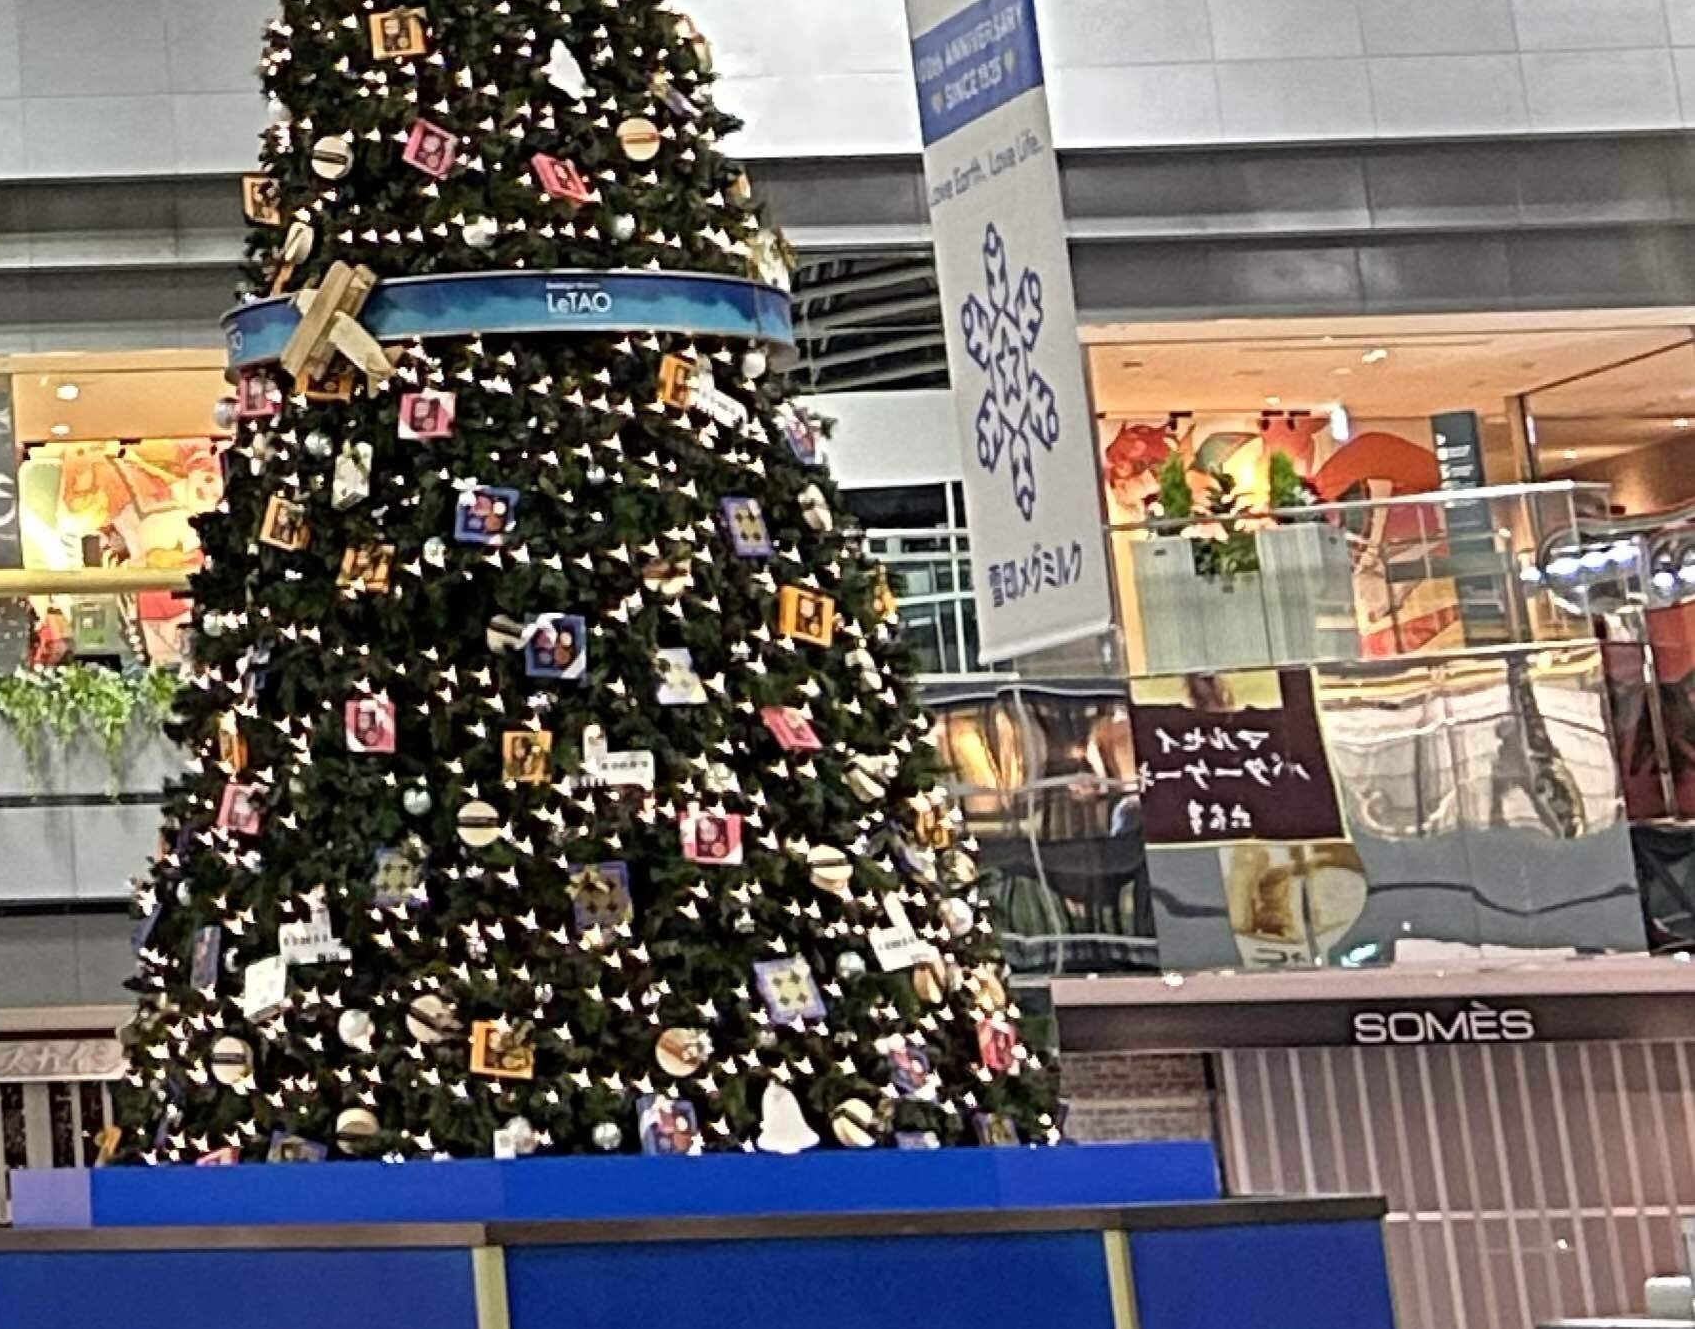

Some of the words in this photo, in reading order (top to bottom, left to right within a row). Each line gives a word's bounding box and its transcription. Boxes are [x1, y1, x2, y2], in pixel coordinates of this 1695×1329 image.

[943, 68, 980, 111] SINCE
[545, 291, 613, 314] LeTAO
[988, 538, 1082, 608] 雪印メグミルク
[1354, 1002, 1535, 1044] SOMÈS
